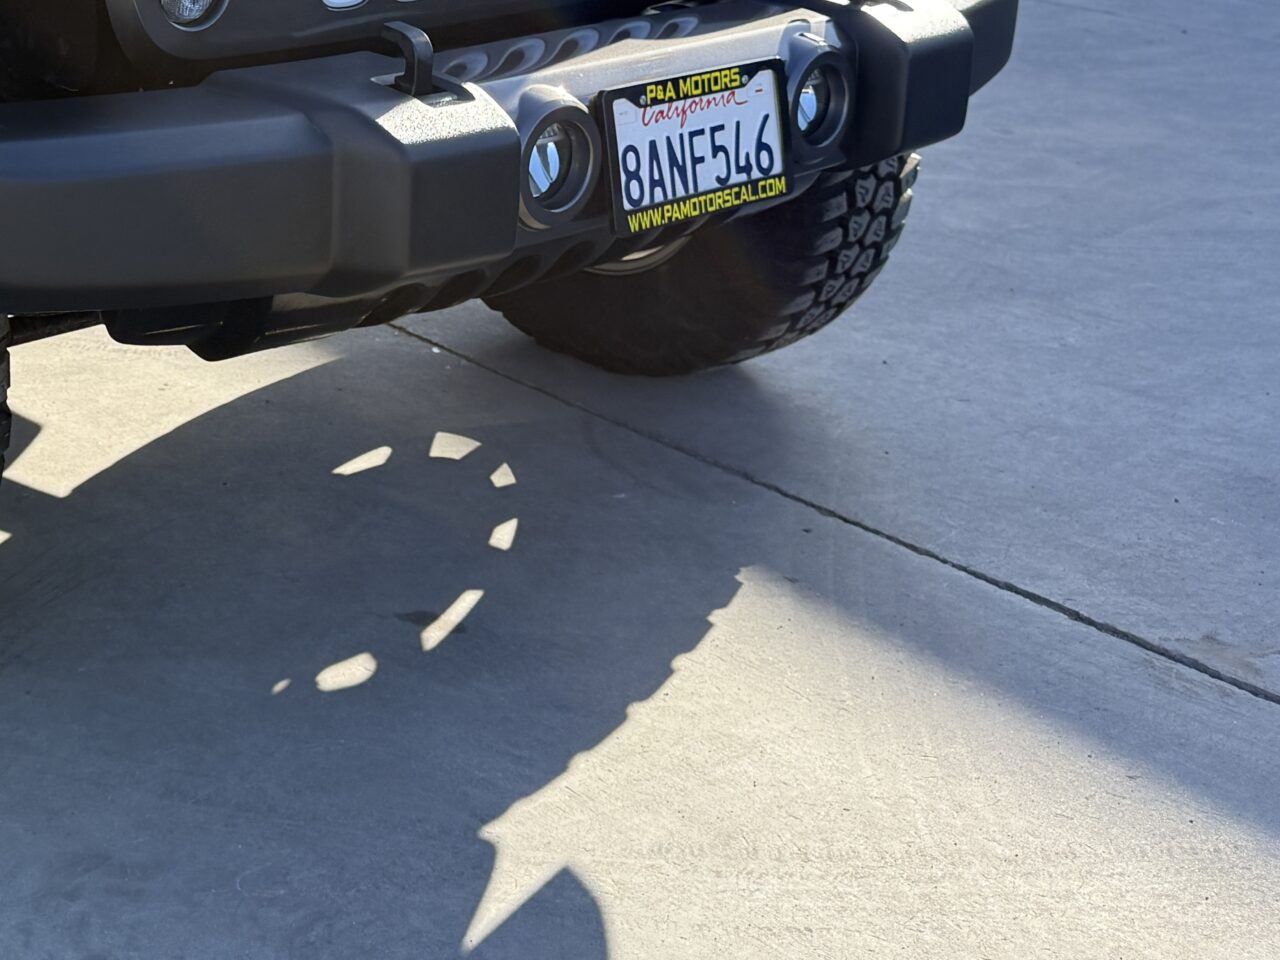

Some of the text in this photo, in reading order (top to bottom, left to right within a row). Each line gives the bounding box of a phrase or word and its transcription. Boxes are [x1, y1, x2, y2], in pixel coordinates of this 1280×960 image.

[641, 89, 748, 129] California
[646, 67, 741, 104] P&A MOTORS
[620, 112, 775, 209] 8ANF546
[627, 176, 787, 233] WWW.PAMOTORSCAL.COM
